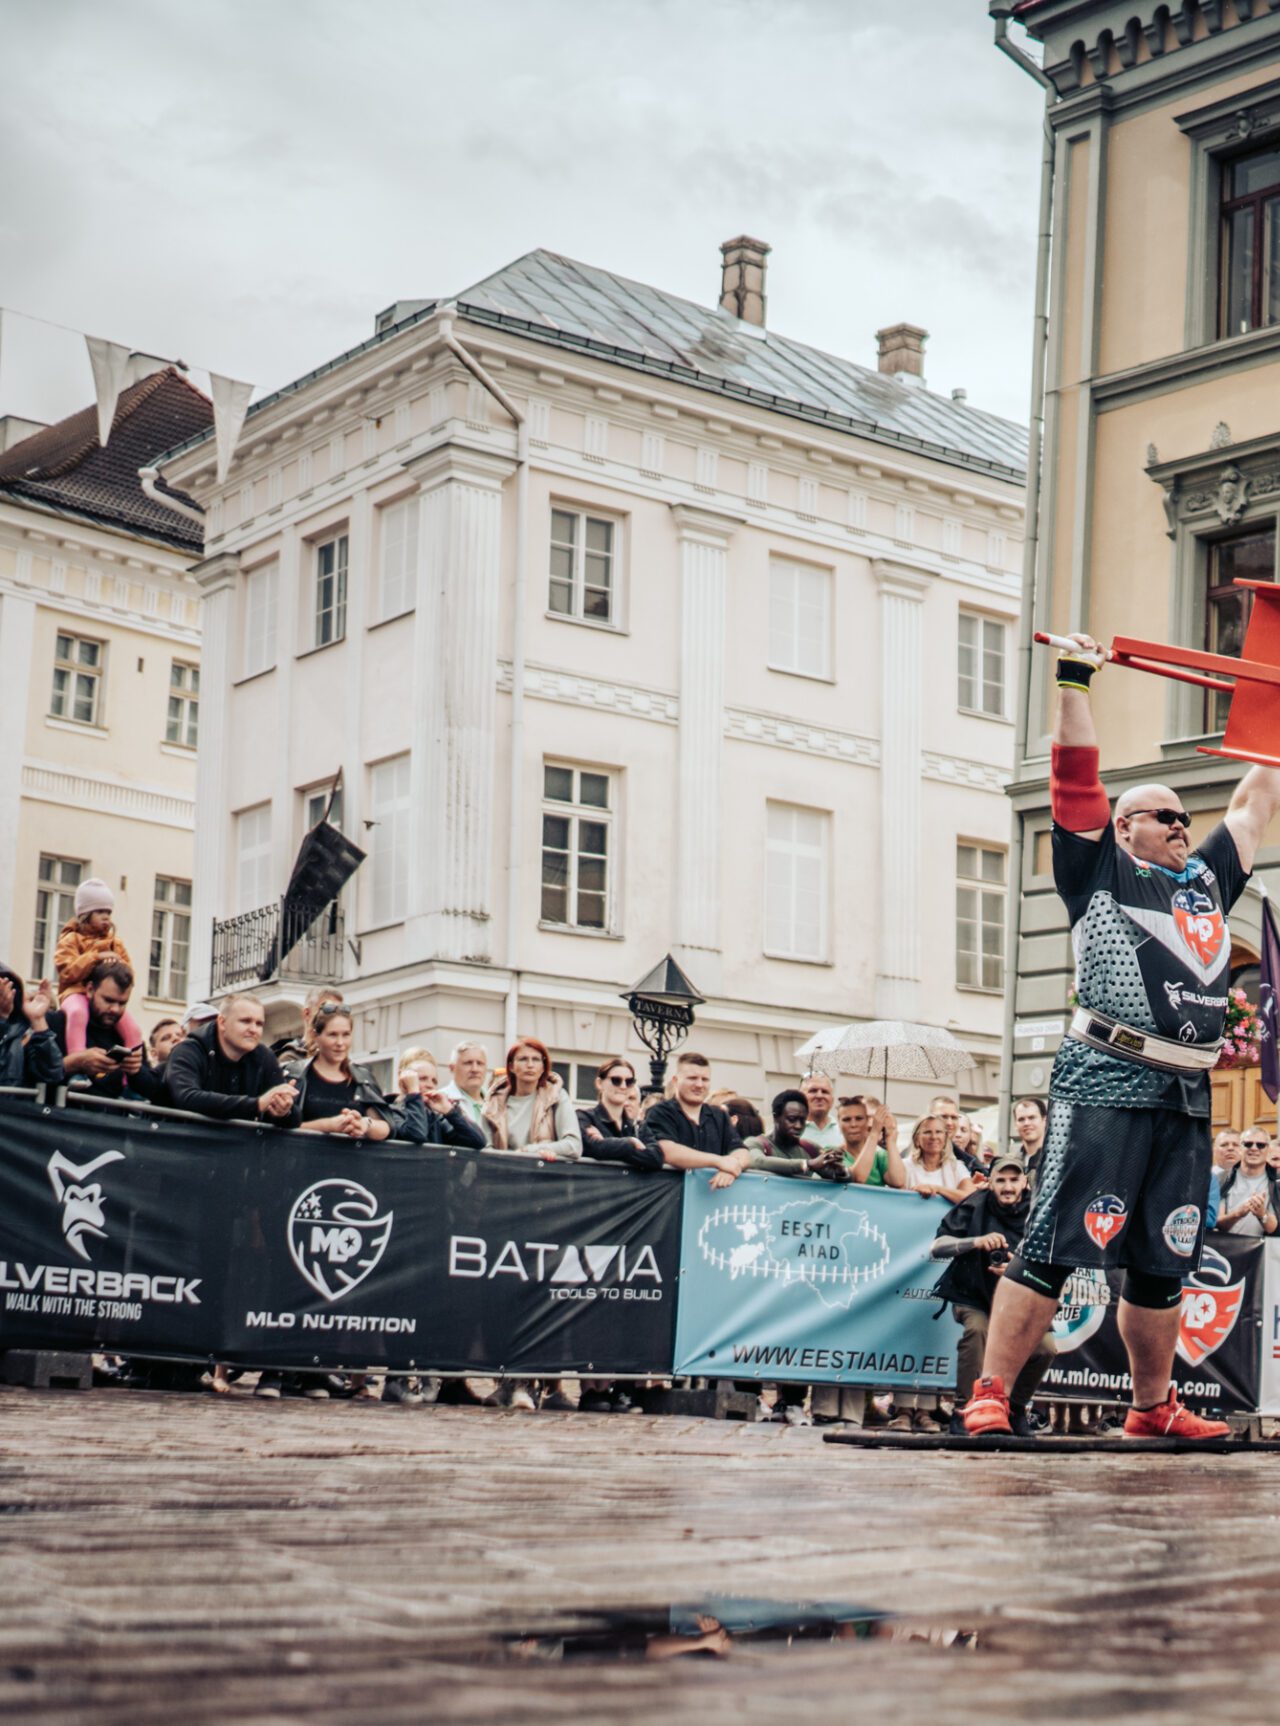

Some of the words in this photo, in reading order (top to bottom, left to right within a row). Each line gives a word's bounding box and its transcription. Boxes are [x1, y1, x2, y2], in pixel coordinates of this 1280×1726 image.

[635, 1000, 690, 1020] TAVERNA
[781, 1220, 831, 1239] EESTI
[449, 1235, 663, 1283] BATAVIA
[797, 1243, 841, 1260] AIAD
[549, 1287, 598, 1300] TOOLS
[600, 1288, 620, 1300] TO
[623, 1288, 663, 1301] BUILD
[1059, 1275, 1111, 1306] PIONS
[5, 1292, 40, 1312] WALK
[42, 1295, 72, 1315] WITH
[74, 1298, 96, 1317] THE
[98, 1301, 143, 1321] STRONG
[246, 1311, 296, 1328] MLO
[302, 1313, 416, 1333] NUTRITION
[732, 1344, 950, 1375] WWW.EESTIAIAD.EE
